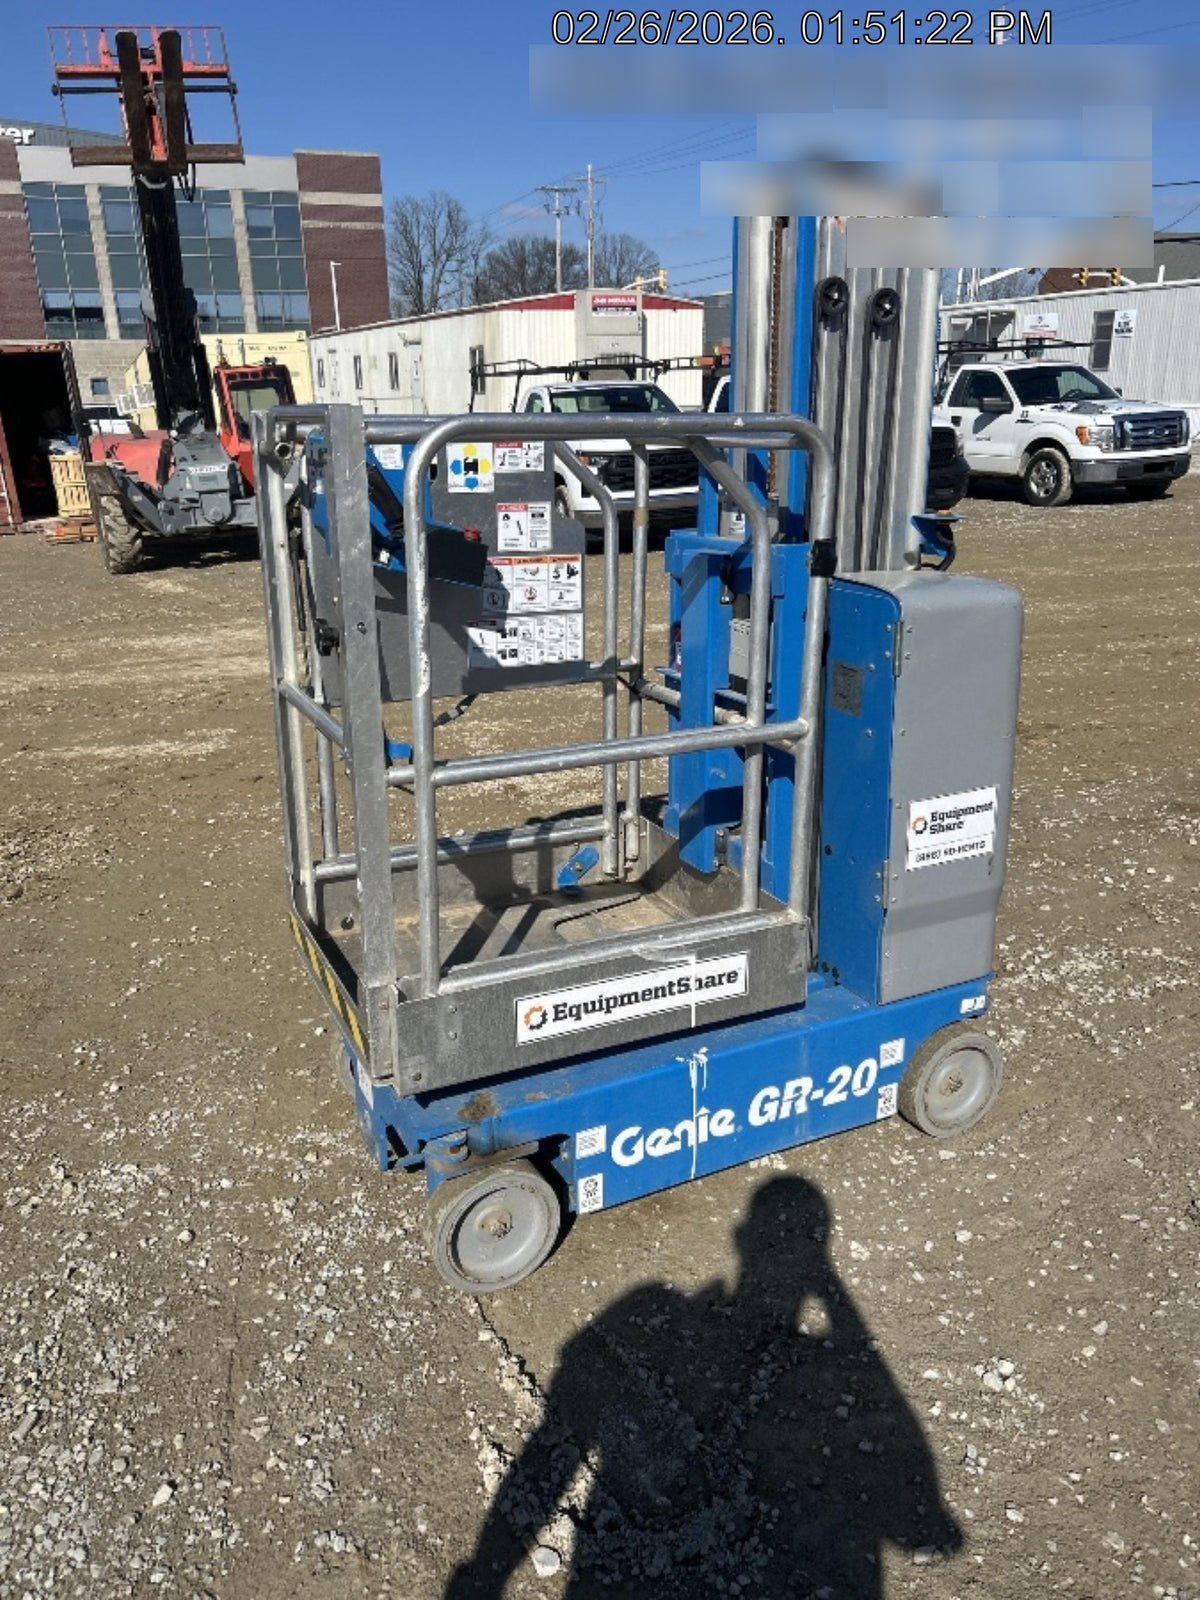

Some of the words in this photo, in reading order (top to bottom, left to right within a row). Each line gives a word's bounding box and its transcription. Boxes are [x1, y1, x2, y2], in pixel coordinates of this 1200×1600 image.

[930, 801, 993, 823] Equipment
[929, 821, 964, 834] Share
[611, 1106, 736, 1167] Genie
[748, 1058, 878, 1127] GR-20
